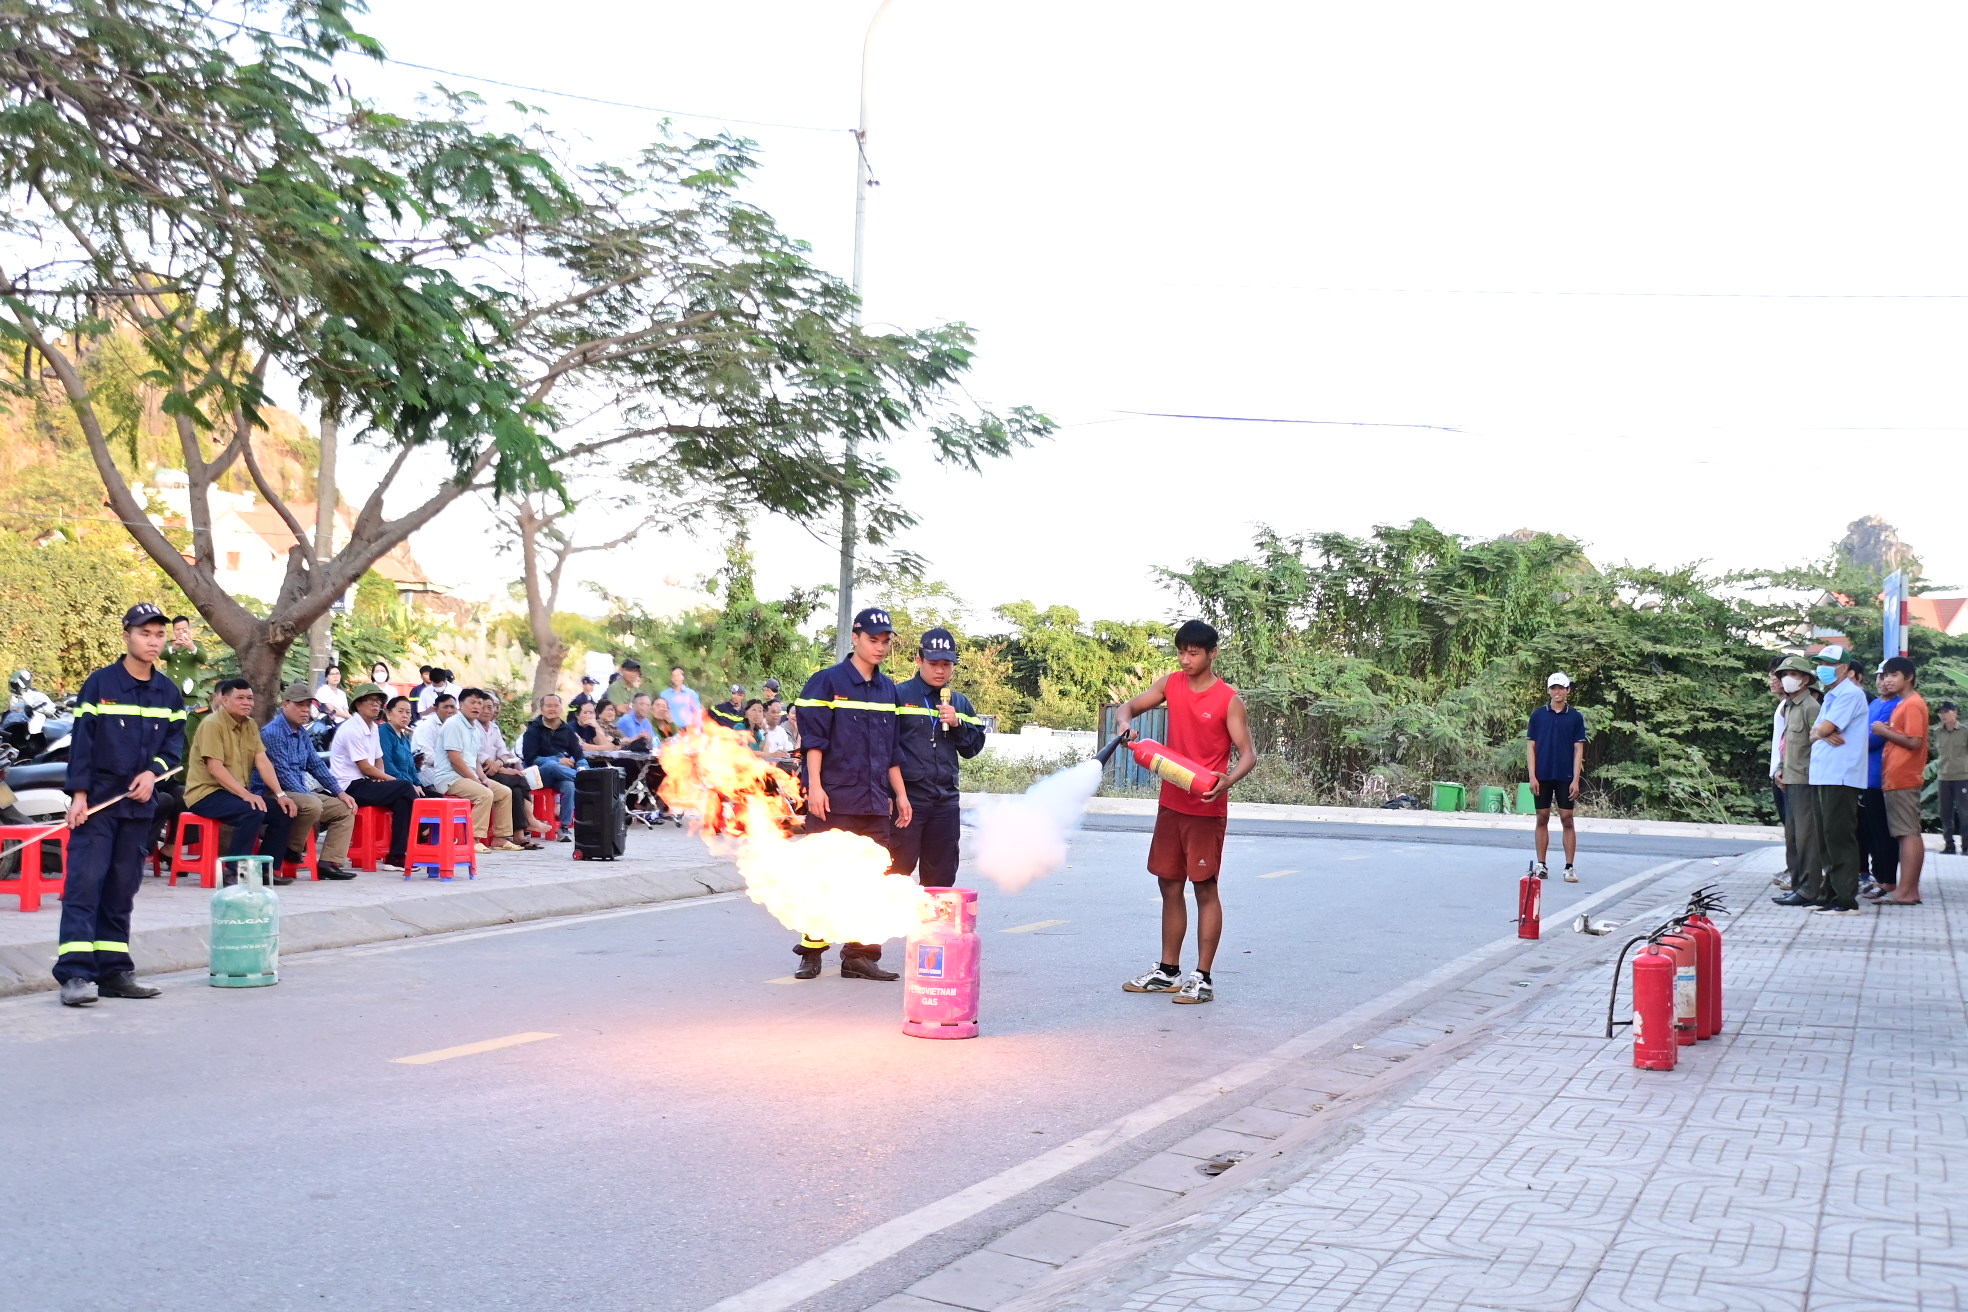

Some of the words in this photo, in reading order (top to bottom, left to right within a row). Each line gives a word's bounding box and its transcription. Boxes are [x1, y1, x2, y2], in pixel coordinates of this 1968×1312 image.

[870, 613, 890, 625] 114
[931, 638, 951, 650] 114
[921, 997, 938, 1006] GAS
